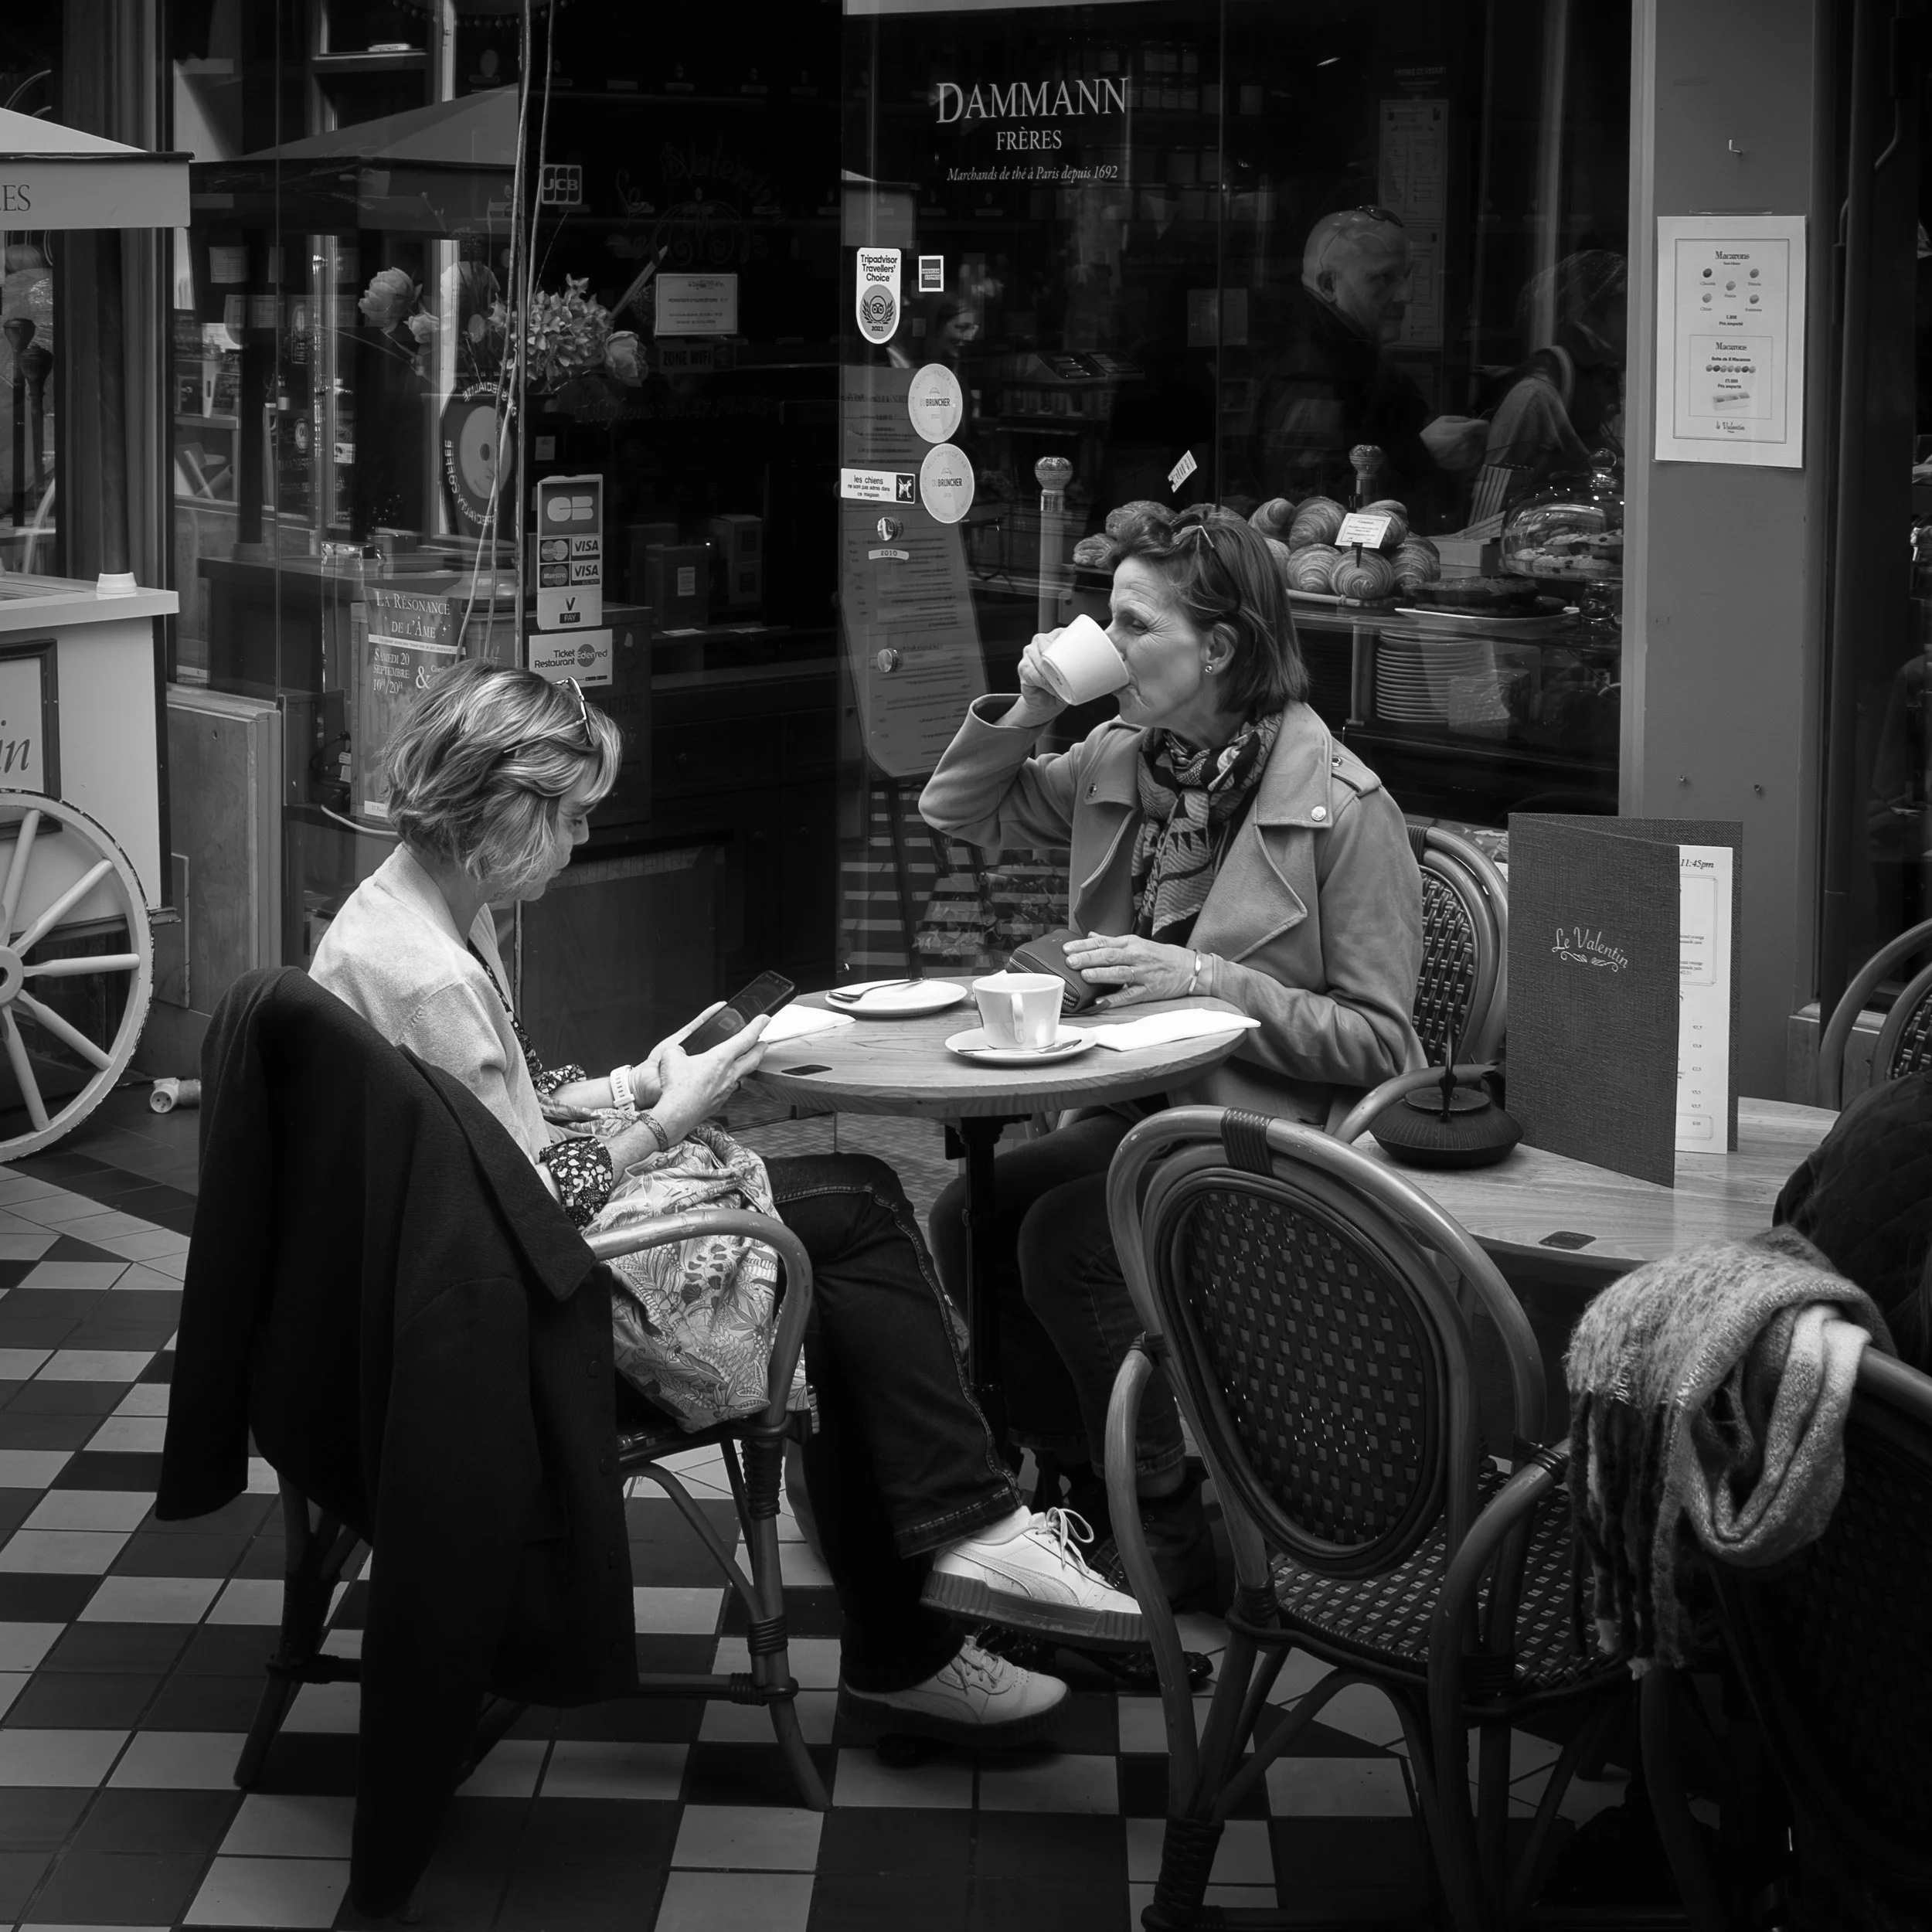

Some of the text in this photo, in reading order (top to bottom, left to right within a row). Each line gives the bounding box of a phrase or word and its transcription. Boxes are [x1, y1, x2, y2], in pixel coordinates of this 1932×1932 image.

[936, 78, 1128, 124] DAMMANN
[996, 126, 1062, 150] FRÈRES
[947, 165, 1118, 182] Marchands de thé à Paris depuis 1692
[543, 179, 579, 190] JCB
[860, 254, 898, 264] Tripadvisor
[862, 264, 896, 273] Travellers'
[866, 274, 890, 282] Choice
[663, 349, 712, 366] ZONE WIFI
[853, 474, 884, 485] les chiens
[575, 540, 599, 552] VISA
[575, 565, 599, 577] VISA
[376, 591, 450, 615] LA RÉSONANCE
[566, 597, 576, 611] V
[563, 614, 577, 622] PAY
[391, 621, 403, 633] DE
[400, 652, 410, 665] 20
[553, 648, 608, 659] Ticket Edenred
[534, 658, 575, 668] Restaurant
[373, 665, 410, 679] SEPTEMBRE
[1551, 927, 1628, 968] Le Valentin
